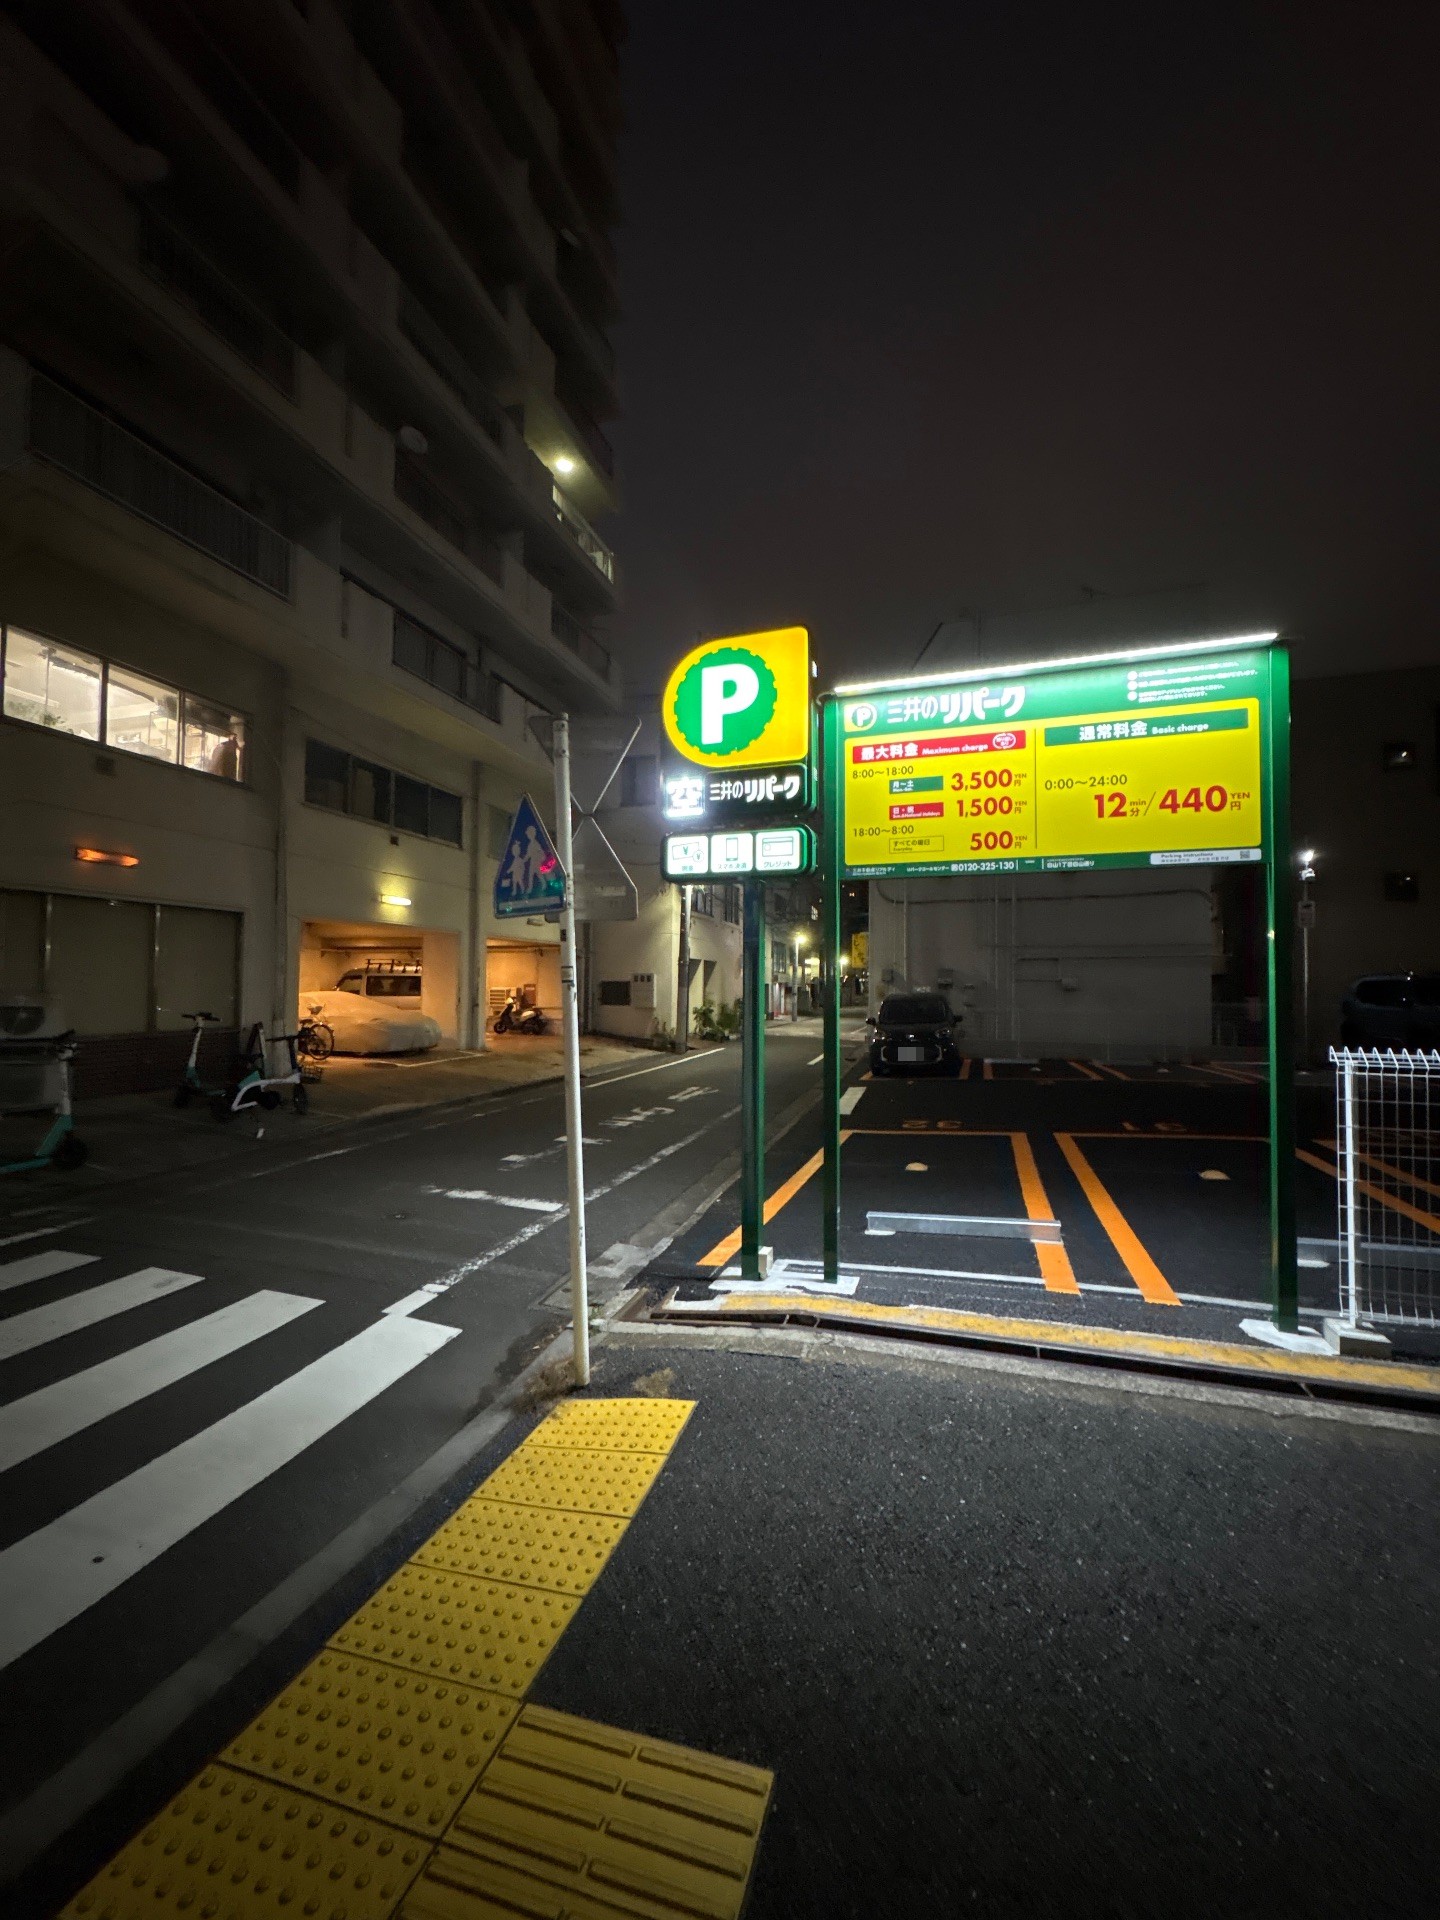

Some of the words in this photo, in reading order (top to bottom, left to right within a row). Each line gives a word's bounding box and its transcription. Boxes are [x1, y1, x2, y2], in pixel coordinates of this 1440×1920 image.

[701, 663, 760, 745] P
[886, 686, 1026, 724] 三井のリパーク
[856, 708, 871, 727] P
[1079, 721, 1148, 741] 通常料金
[1152, 725, 1175, 735] Basic
[1177, 723, 1209, 733] charge
[861, 743, 919, 761] 最大料金
[922, 746, 961, 756] Maximum
[962, 743, 988, 753] charge
[852, 766, 914, 779] 8:00〜18:00
[951, 769, 1013, 791] 3,500
[1045, 774, 1128, 790] 0:00〜24:00
[709, 775, 800, 803] 三井のリパーク
[956, 796, 1013, 818] 1,500
[1094, 792, 1127, 818] 12
[1159, 785, 1228, 814] 440
[1230, 792, 1250, 800] YEN
[1230, 801, 1241, 811] 円
[1130, 807, 1140, 816] 分
[853, 825, 914, 837] 18:00〜8:00
[893, 838, 930, 847] すべての曜日
[970, 831, 1013, 851] 500
[958, 861, 1015, 872] 0120-325-130
